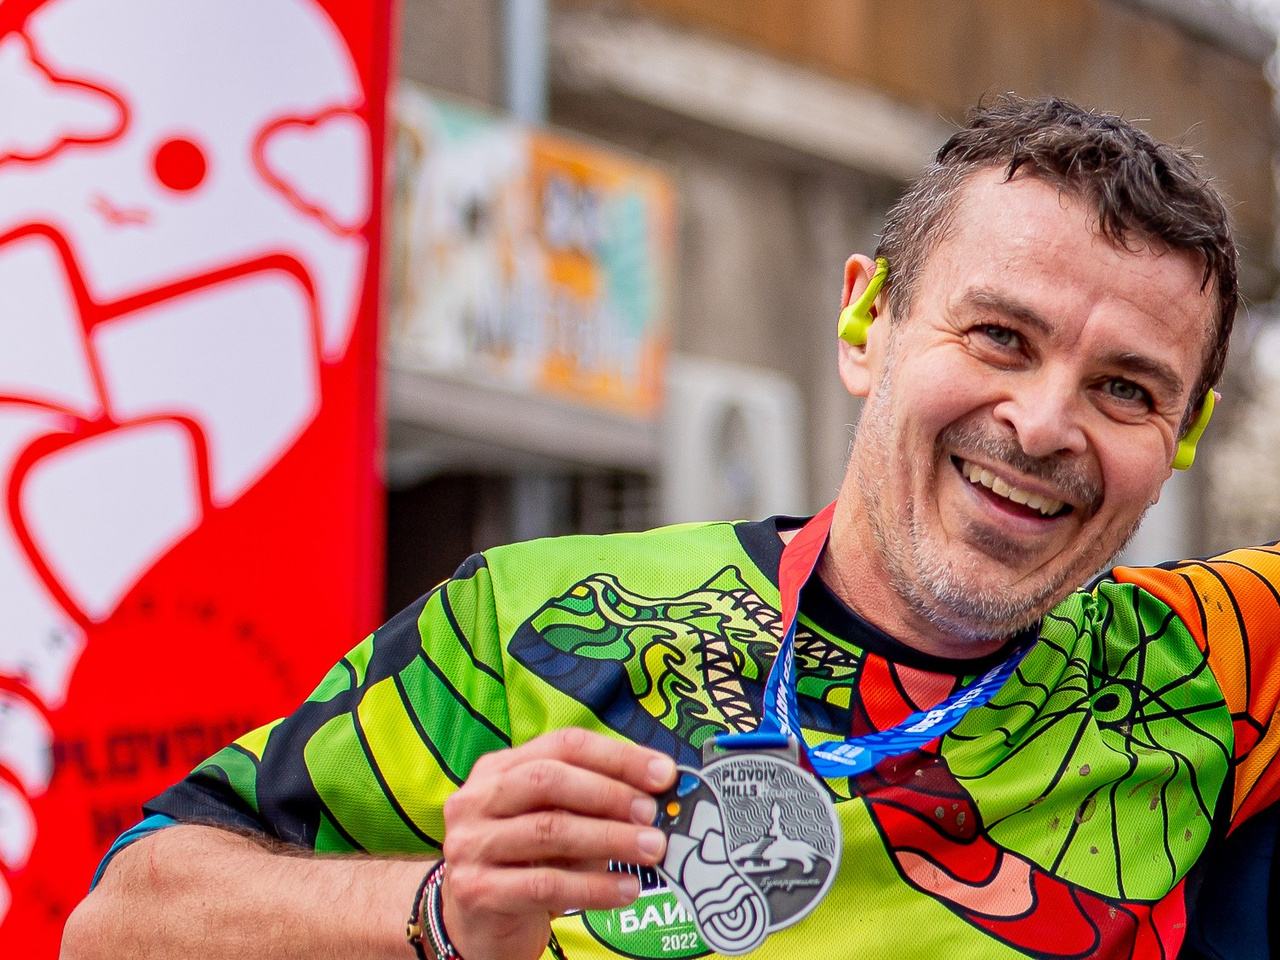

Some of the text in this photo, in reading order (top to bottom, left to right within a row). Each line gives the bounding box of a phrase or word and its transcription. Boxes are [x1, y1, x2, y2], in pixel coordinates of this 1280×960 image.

[721, 768, 777, 782] PLOVDIV
[721, 784, 758, 798] HILLS
[661, 932, 698, 952] 2022
